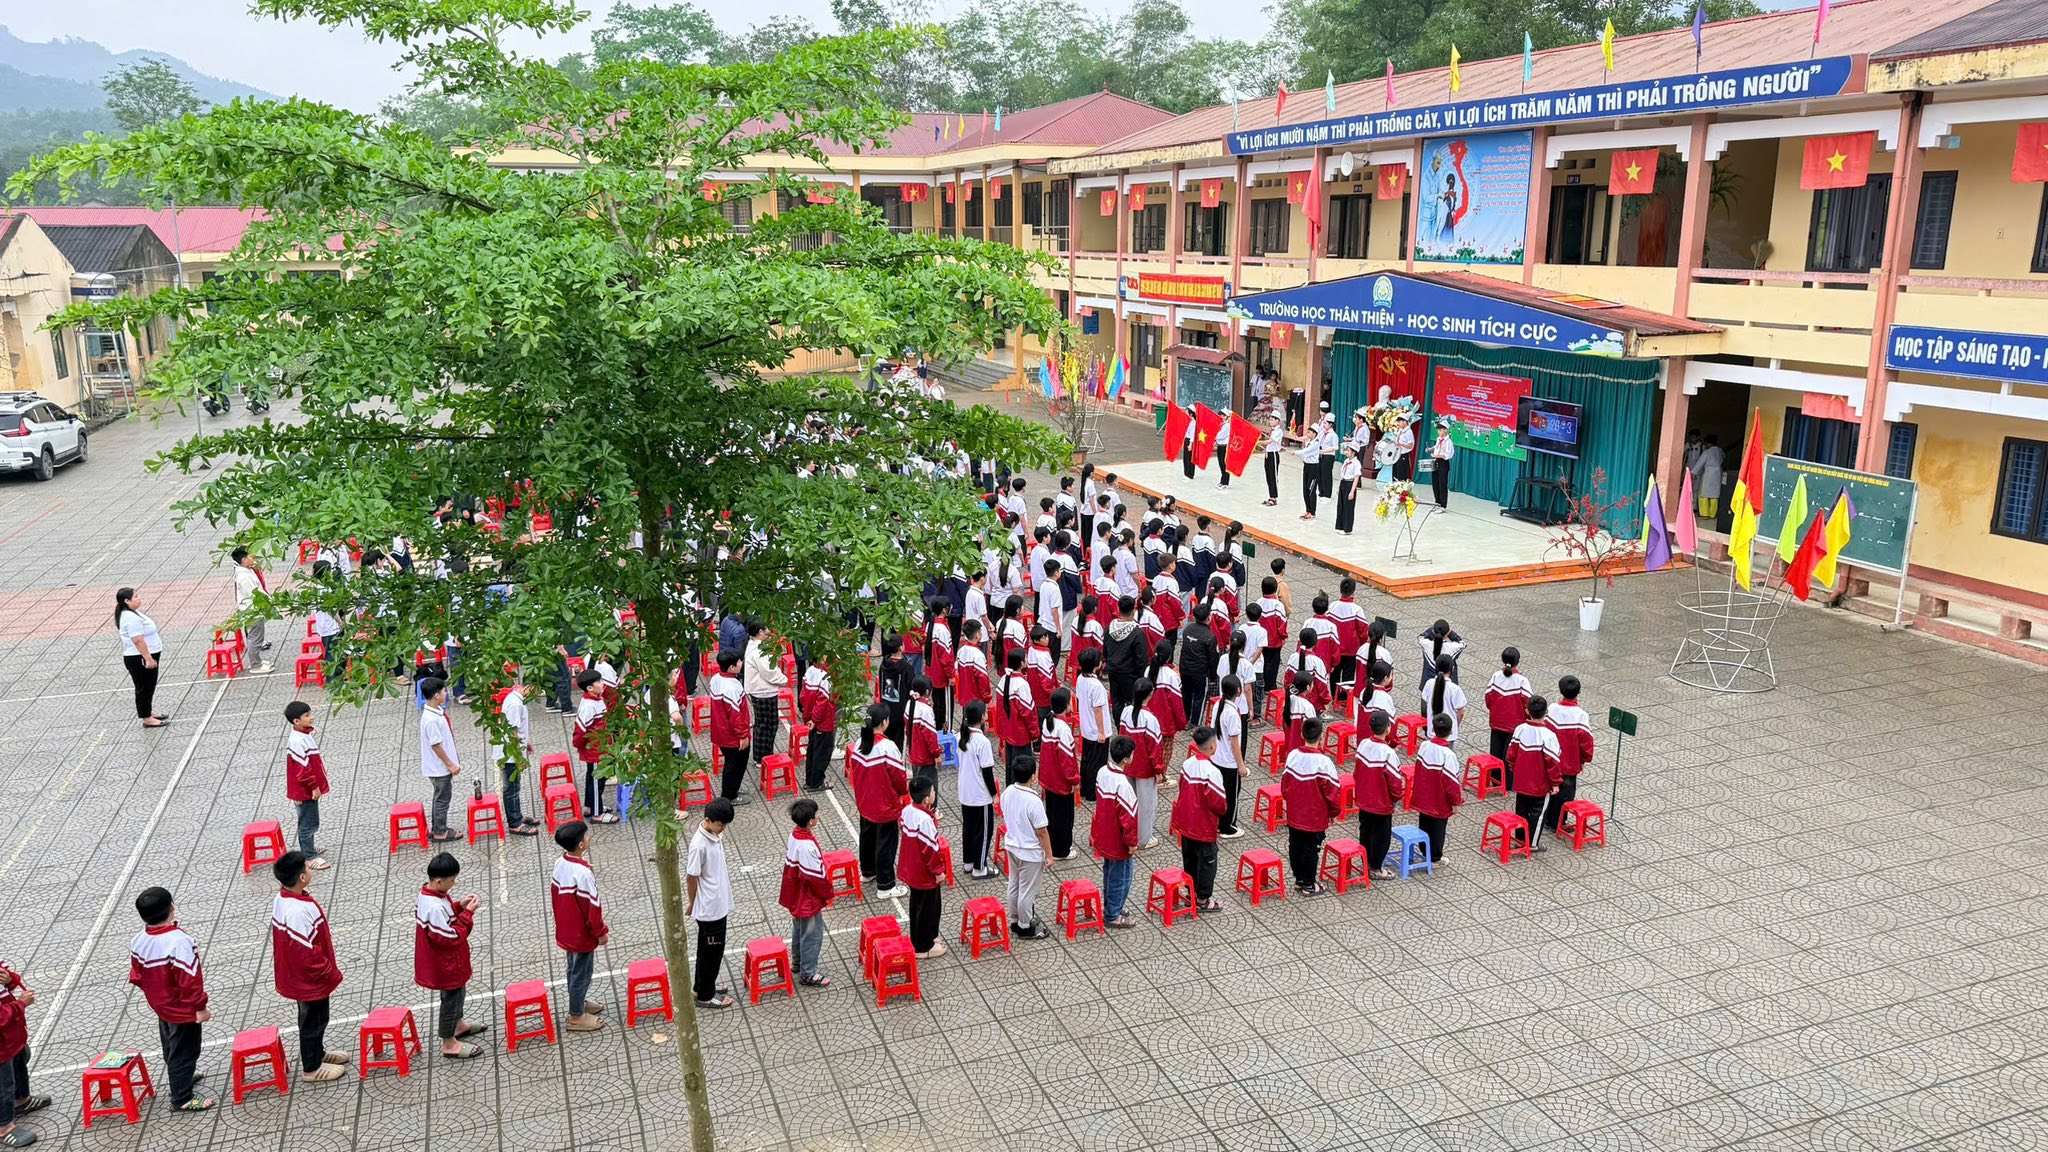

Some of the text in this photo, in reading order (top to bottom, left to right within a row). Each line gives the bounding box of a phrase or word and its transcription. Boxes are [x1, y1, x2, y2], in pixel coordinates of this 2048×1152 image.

[1250, 133, 1263, 151] LỢI
[1264, 131, 1278, 147] ÍCH
[1280, 126, 1304, 145] MƯỜI
[1331, 120, 1346, 139] THÌ
[1348, 115, 1373, 138] PHẢI
[1415, 110, 1441, 130] CÂY,
[1444, 106, 1457, 127] VÌ
[1460, 106, 1480, 128] LỢI
[1484, 102, 1507, 123] ÍCH
[1510, 97, 1551, 120] TRĂM
[1555, 92, 1592, 116] NĂM
[1596, 87, 1622, 112] THÌ
[1625, 80, 1668, 109] PHẢI
[1672, 75, 1736, 104] TRỒNG
[1259, 300, 1299, 318] TRƯỜNG
[1302, 306, 1326, 323] HỌC
[1329, 305, 1359, 323] THÂN
[1361, 308, 1395, 329] THIỆN
[1407, 314, 1439, 333] HỌC
[1442, 315, 1476, 334] SINH
[1480, 316, 1516, 338] TÍCH
[1520, 322, 1558, 345] CỰC
[1894, 336, 1923, 361] HỌC
[1926, 335, 1954, 364] TẬP
[1956, 337, 1999, 365] SÁNG
[2001, 344, 2032, 371] TẠO
